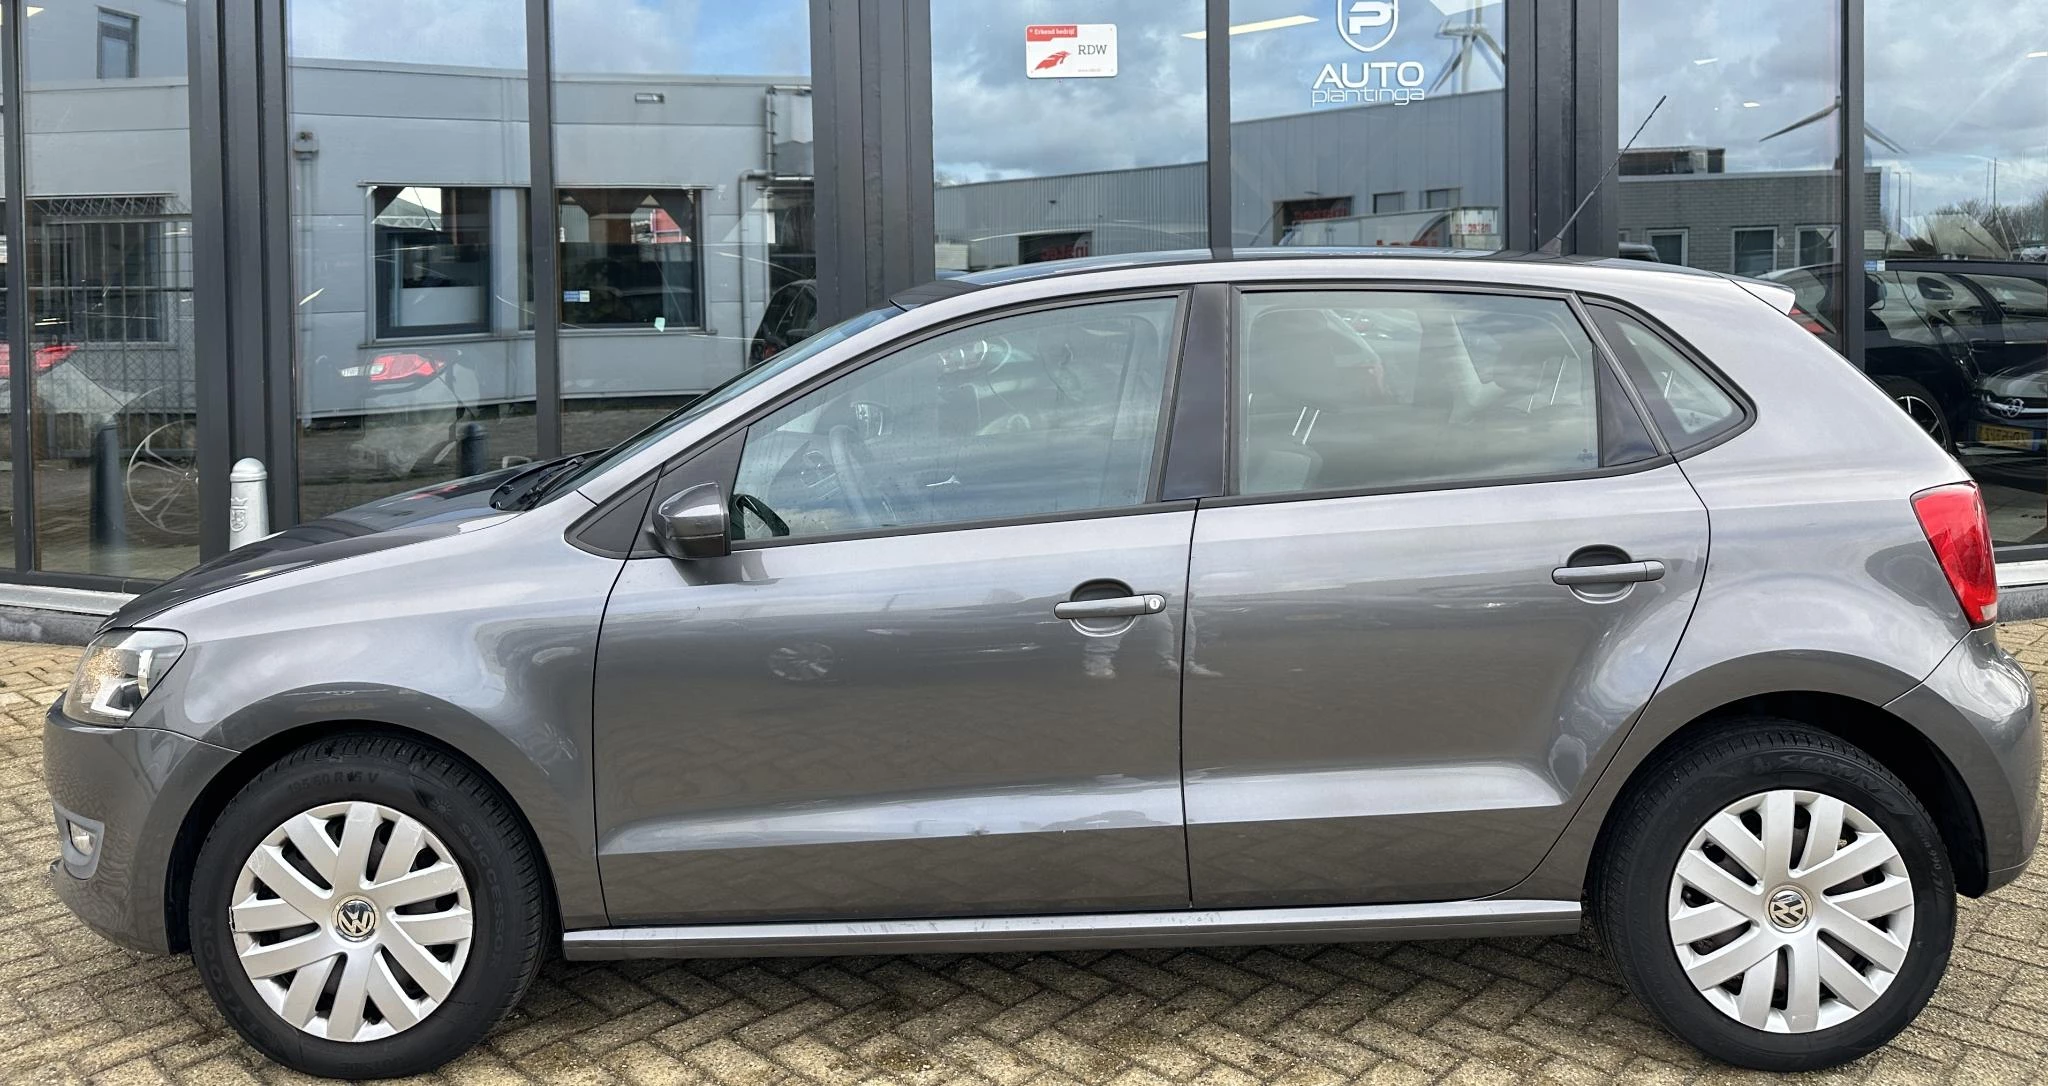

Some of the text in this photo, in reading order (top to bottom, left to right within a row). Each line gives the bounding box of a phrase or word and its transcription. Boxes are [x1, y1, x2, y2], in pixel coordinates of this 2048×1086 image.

[1078, 44, 1107, 55] RDW
[1312, 61, 1425, 89] AUTO
[1311, 86, 1425, 107] plantinga
